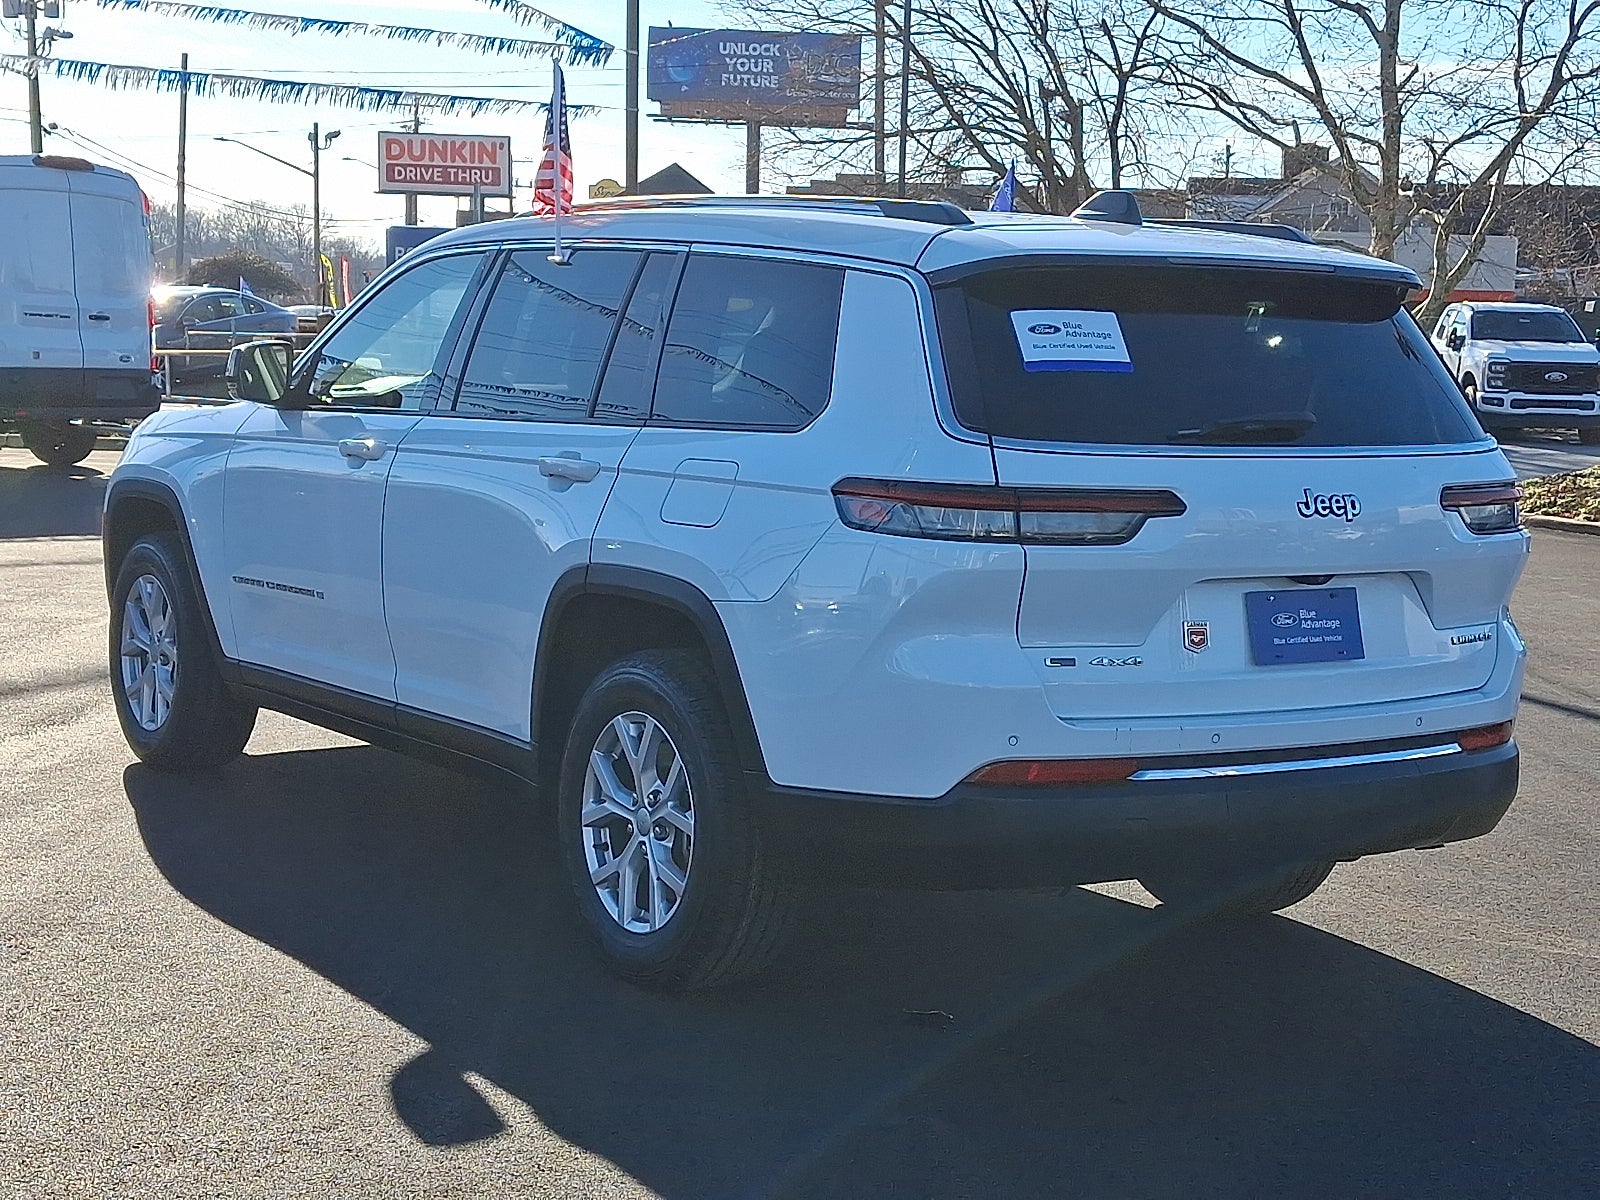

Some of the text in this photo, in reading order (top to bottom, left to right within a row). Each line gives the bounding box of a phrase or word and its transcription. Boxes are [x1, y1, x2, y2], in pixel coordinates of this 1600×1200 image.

[719, 42, 781, 57] UNLOCK
[725, 57, 774, 73] YOUR
[721, 73, 779, 88] FUTURE
[385, 138, 505, 165] DUNKIN'
[394, 166, 493, 183] DRIVE THRU
[1062, 321, 1083, 330] Blue
[1065, 330, 1112, 340] Advantage
[1296, 487, 1361, 522] Jeep
[1299, 609, 1317, 619] Blue
[1301, 620, 1341, 629] Advantage
[1088, 655, 1143, 667] 4x4
